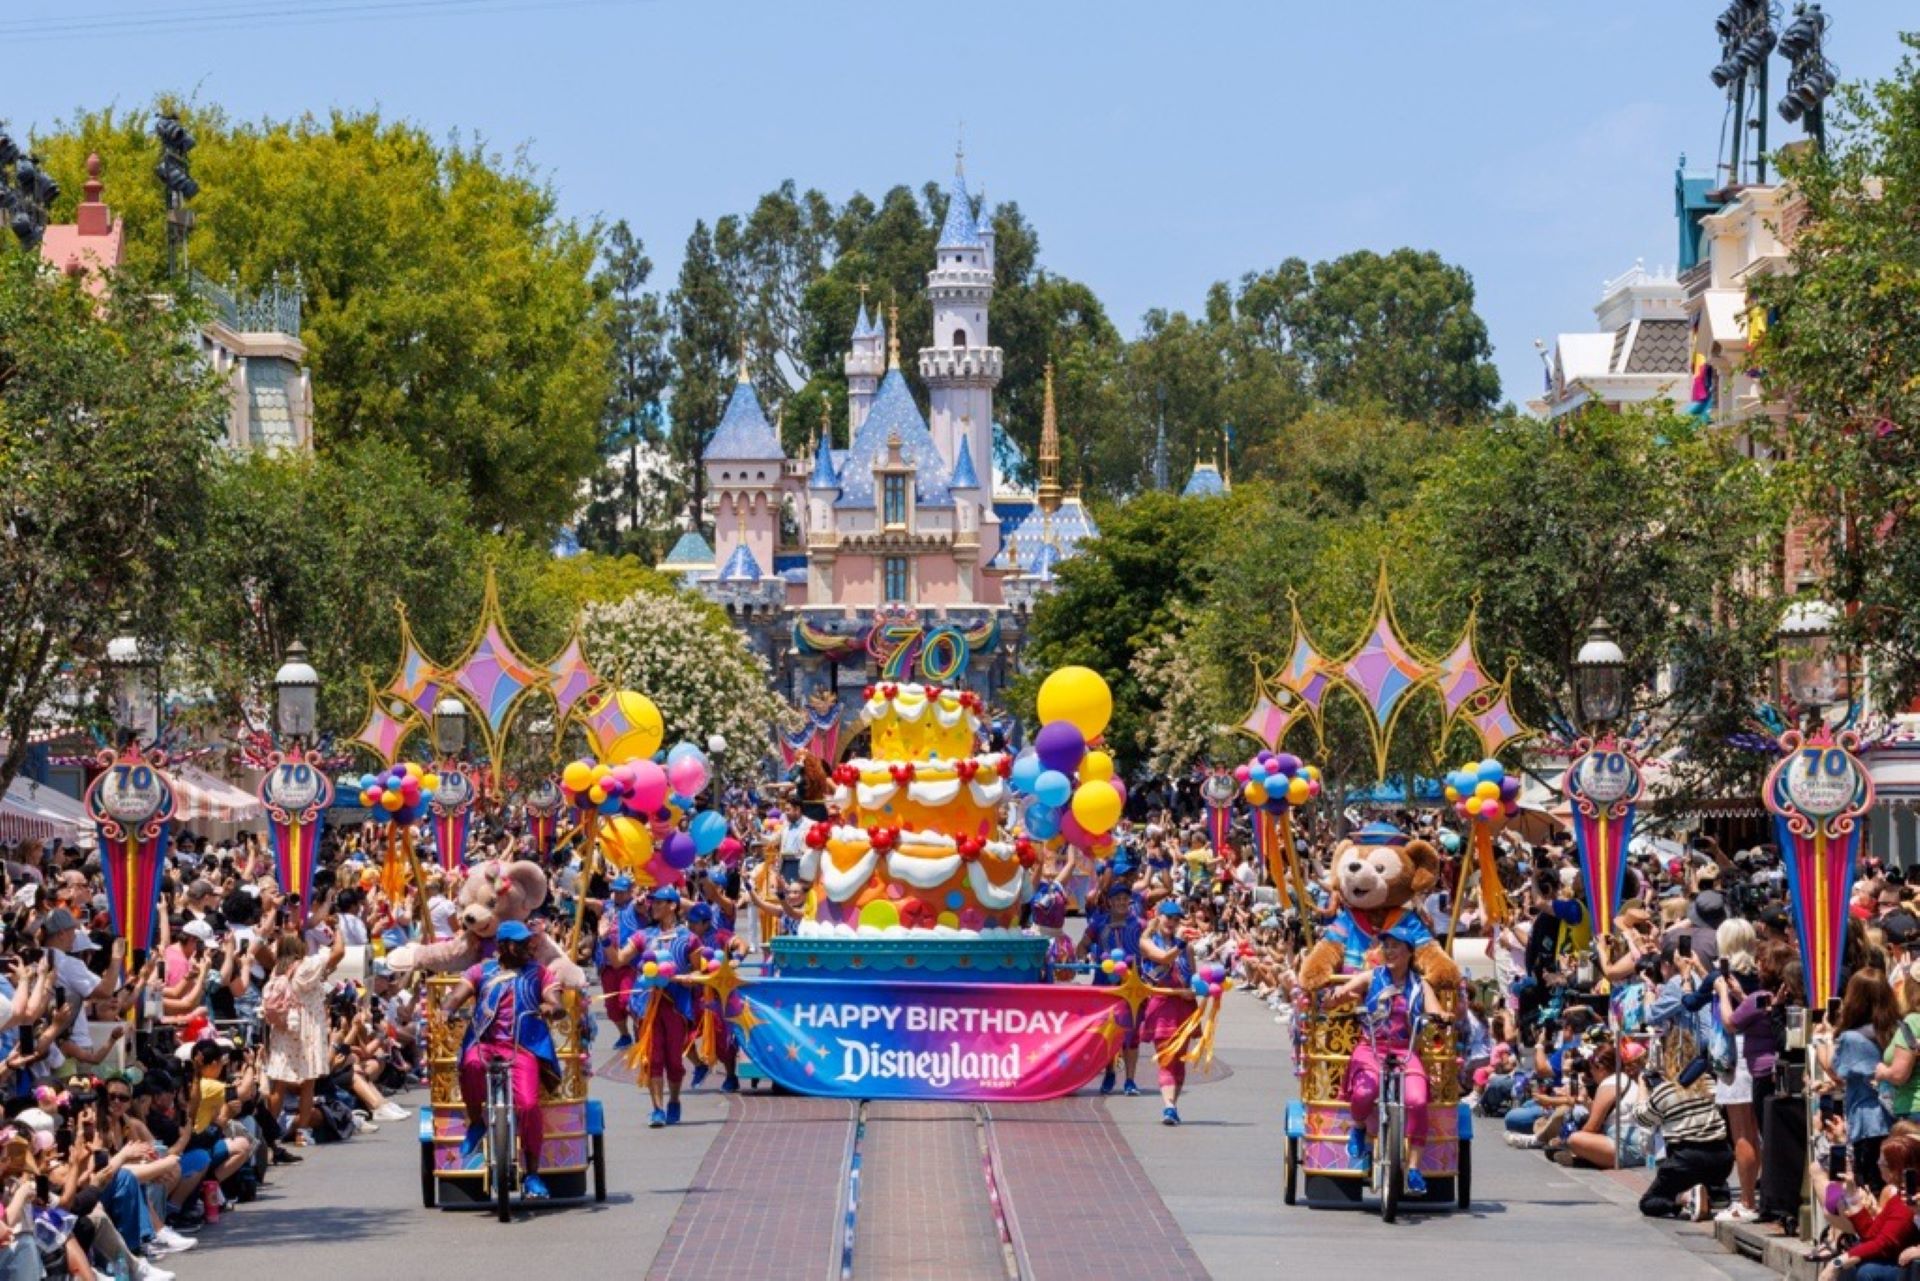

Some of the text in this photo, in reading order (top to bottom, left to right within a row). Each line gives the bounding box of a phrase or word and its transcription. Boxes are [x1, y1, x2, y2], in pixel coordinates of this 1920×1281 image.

[883, 624, 969, 680] 70
[281, 764, 310, 784] 70
[1593, 752, 1625, 773] 70
[1803, 749, 1847, 777] 70
[114, 765, 152, 790] 70
[439, 771, 462, 786] 70
[794, 1003, 1068, 1035] HAPPY BIRTHDAY
[835, 1036, 1022, 1088] Disneyland
